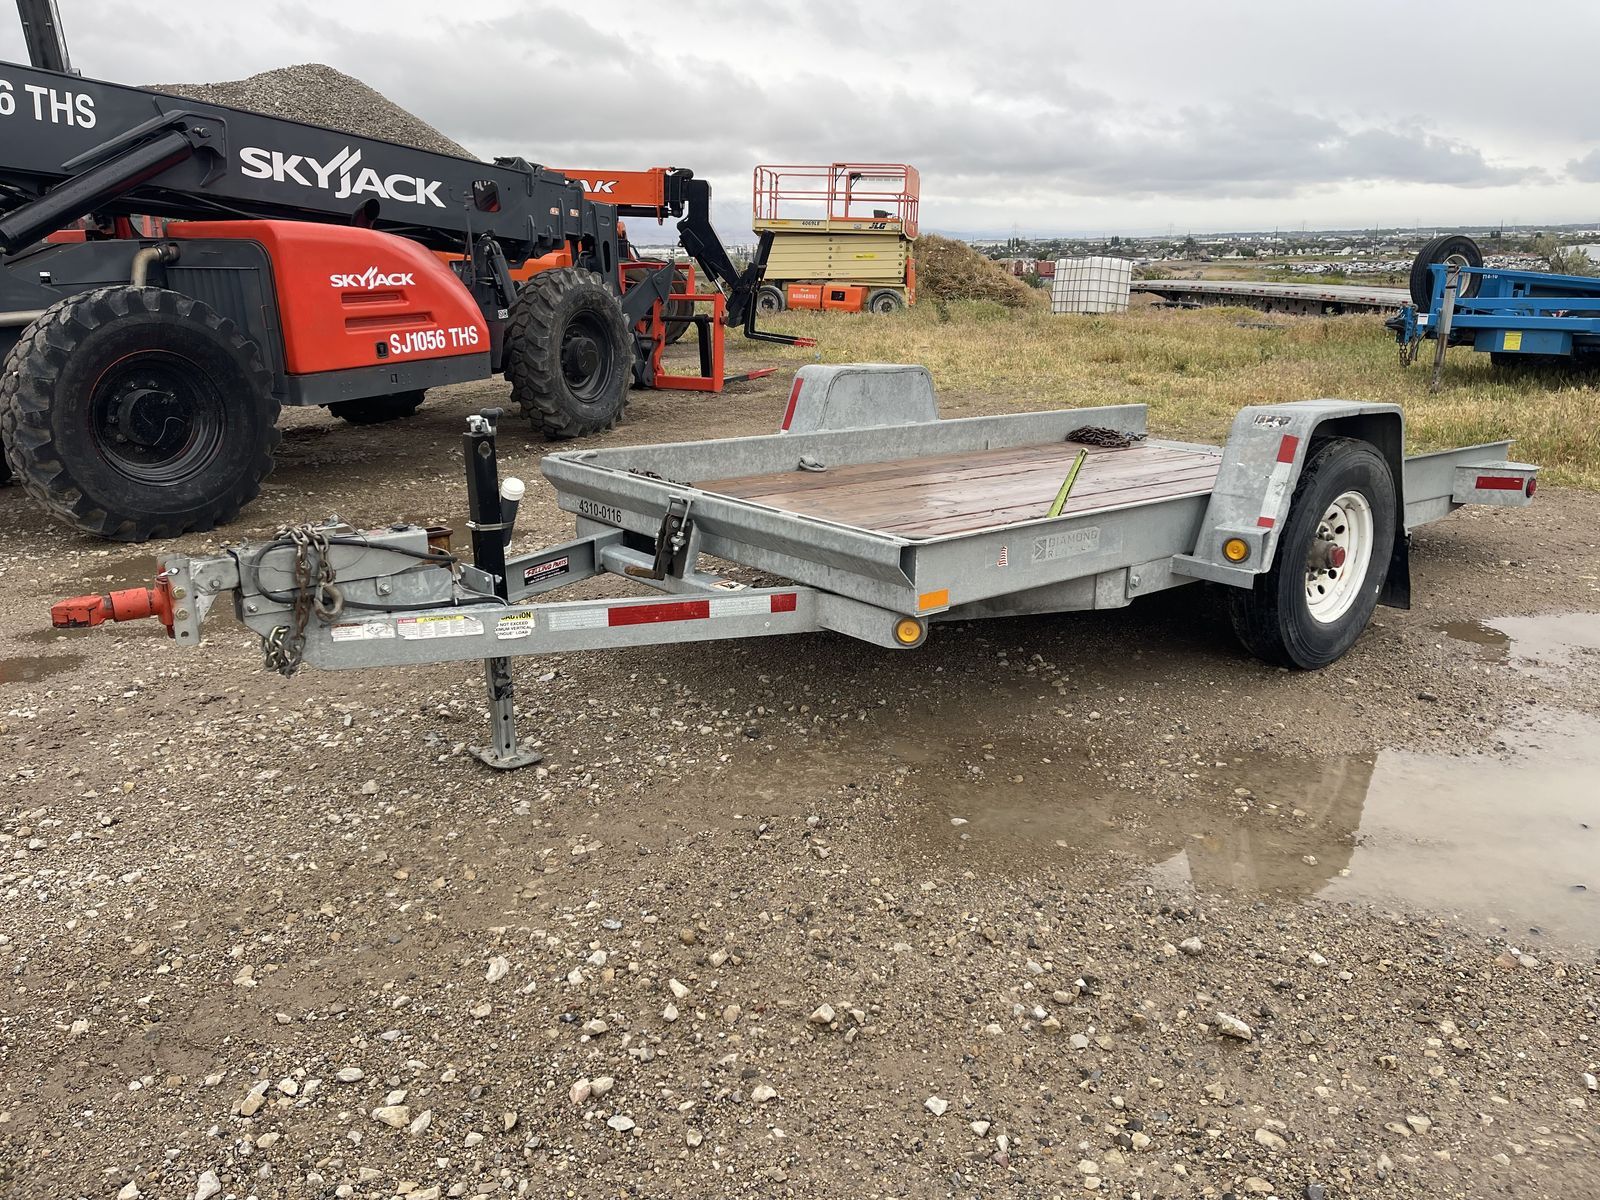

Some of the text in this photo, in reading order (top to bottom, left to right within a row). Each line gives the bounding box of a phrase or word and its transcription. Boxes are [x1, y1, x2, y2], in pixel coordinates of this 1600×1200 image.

[24, 83, 97, 129] THS
[239, 145, 447, 209] SKYJACK
[868, 222, 887, 230] JLG
[329, 265, 416, 290] SKYJACK
[389, 325, 479, 355] SJ1056 THS
[578, 499, 622, 523] 4310-0116
[1048, 529, 1098, 548] DIAMOND
